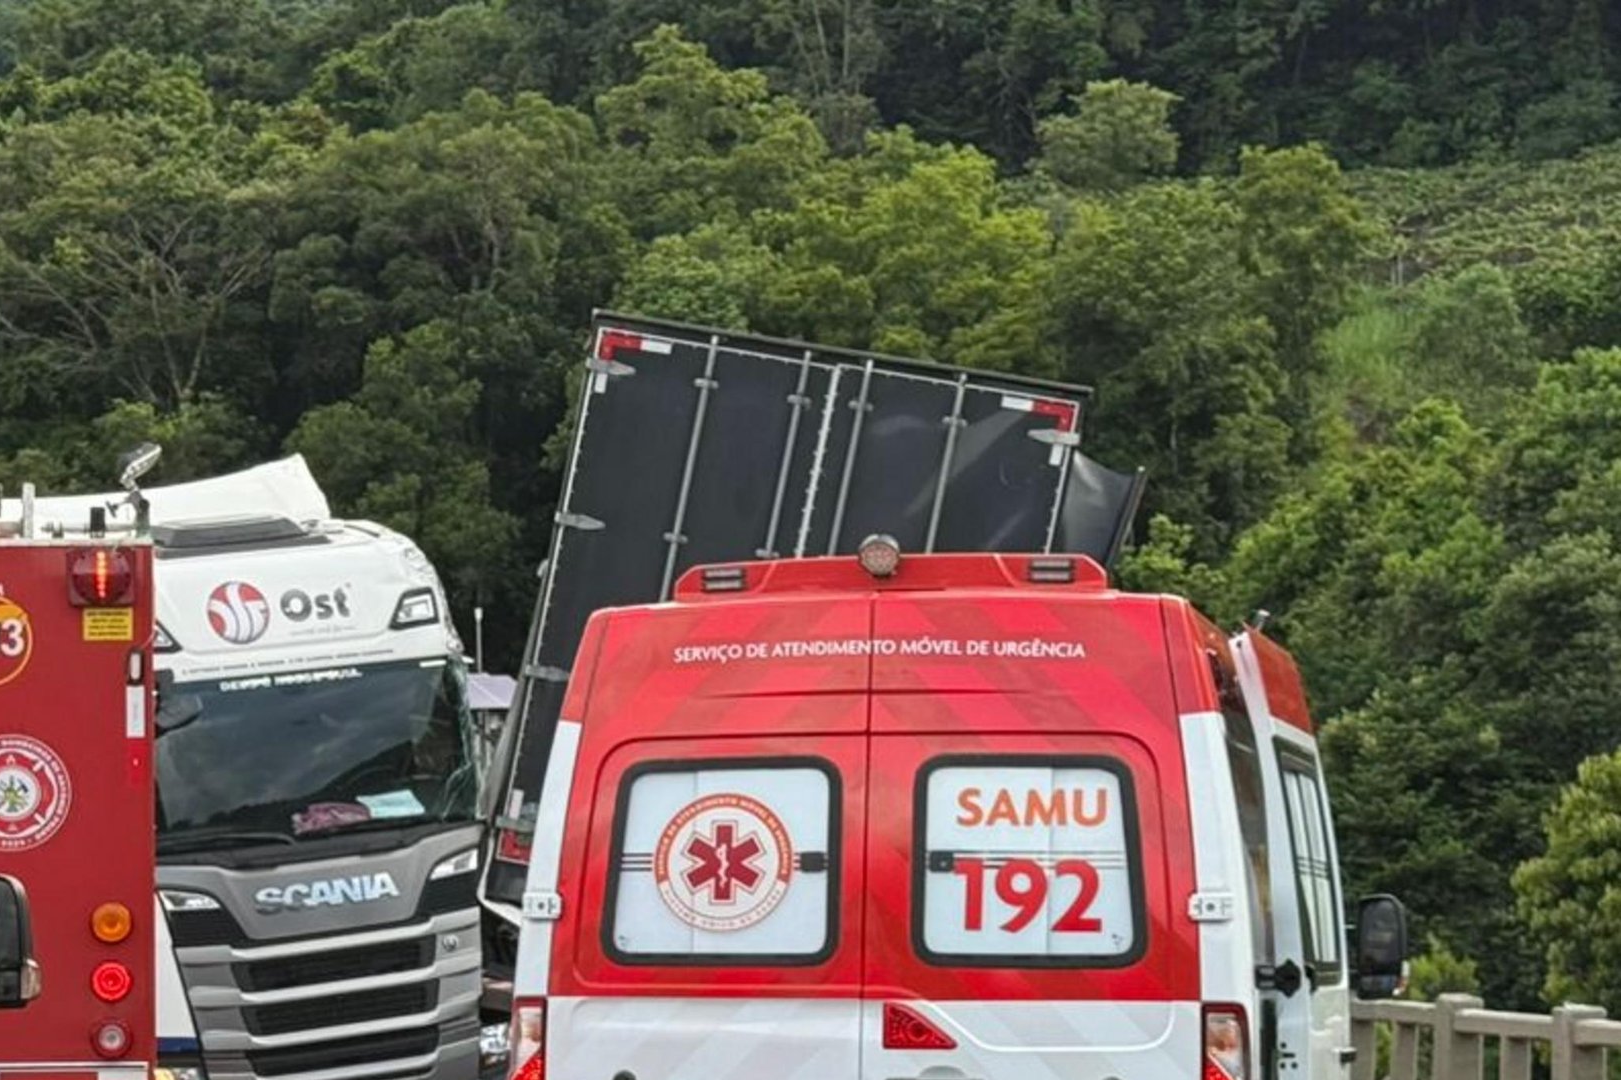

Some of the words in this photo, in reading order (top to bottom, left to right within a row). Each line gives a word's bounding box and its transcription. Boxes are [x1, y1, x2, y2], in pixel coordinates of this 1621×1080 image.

[280, 585, 352, 622] Ost
[673, 641, 741, 664] SERVIÇO
[746, 641, 770, 659] DE
[771, 638, 896, 659] ATENDIMENTO
[900, 635, 963, 657] MÓVEL
[966, 640, 990, 657] DE
[993, 637, 1086, 659] URGÊNCIA
[955, 787, 1108, 828] SAMU
[255, 871, 401, 907] SCANIA
[954, 858, 1103, 935] 192
